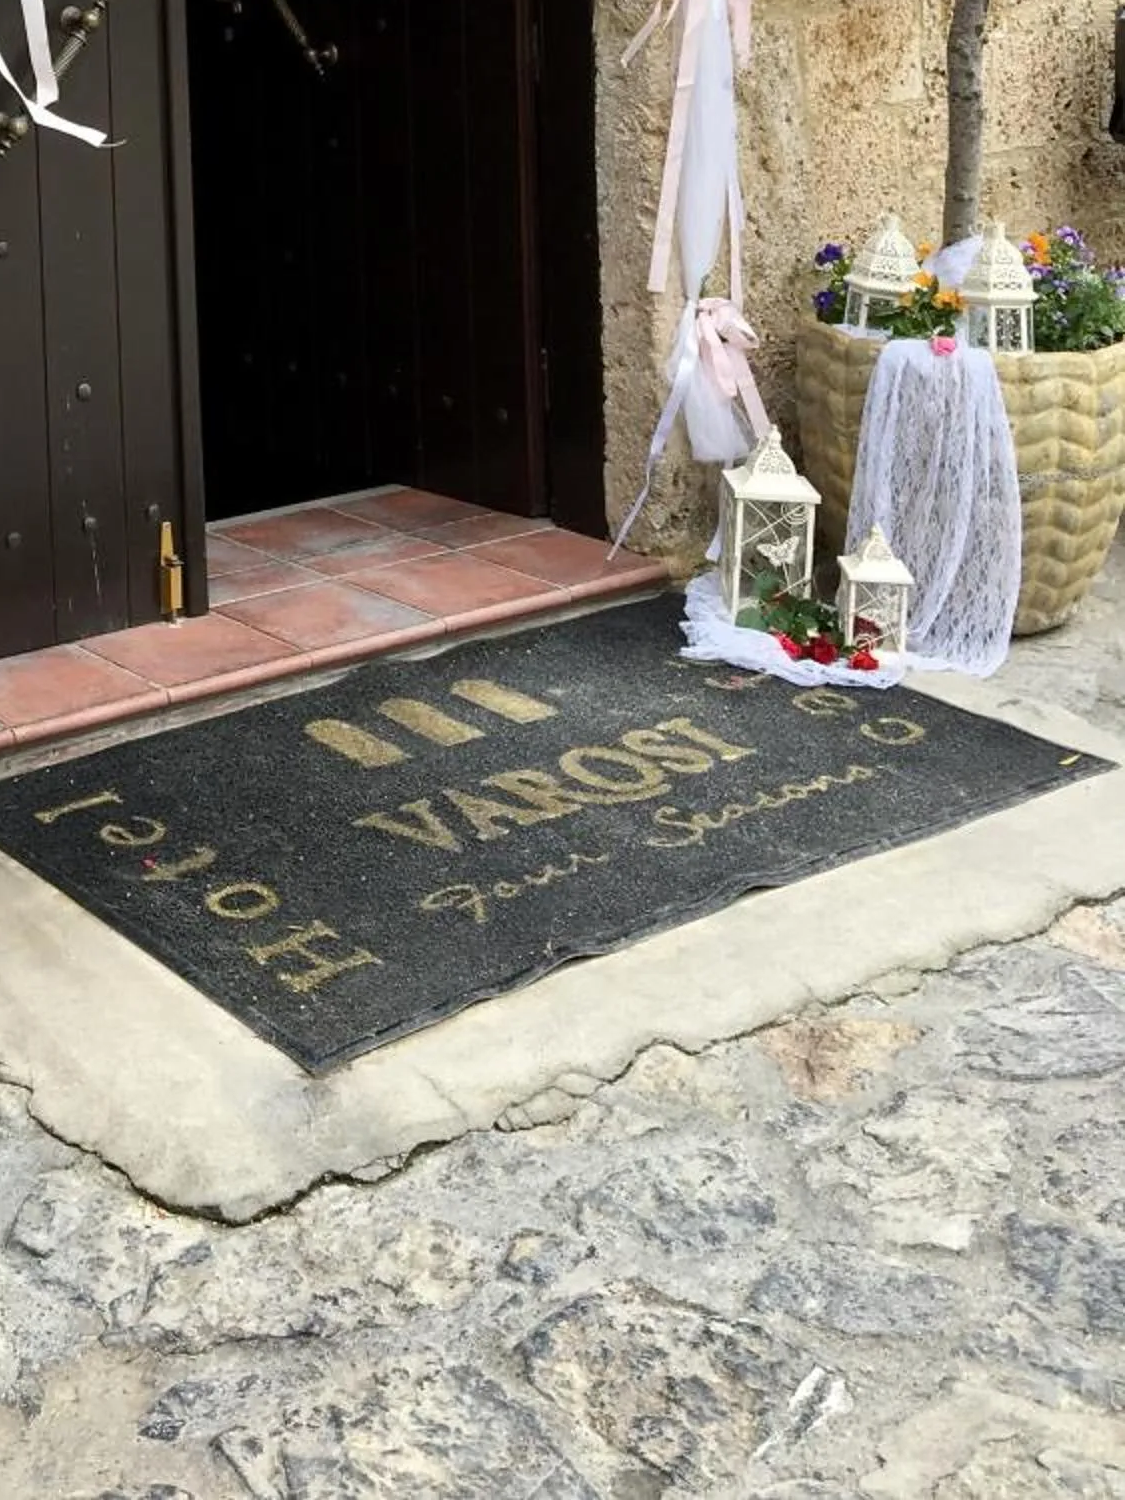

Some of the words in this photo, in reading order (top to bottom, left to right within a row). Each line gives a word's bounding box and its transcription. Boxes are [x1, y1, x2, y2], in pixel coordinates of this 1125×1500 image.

[352, 717, 757, 852] VAROSI
[417, 844, 610, 924] Four
[645, 765, 875, 848] Seasons
